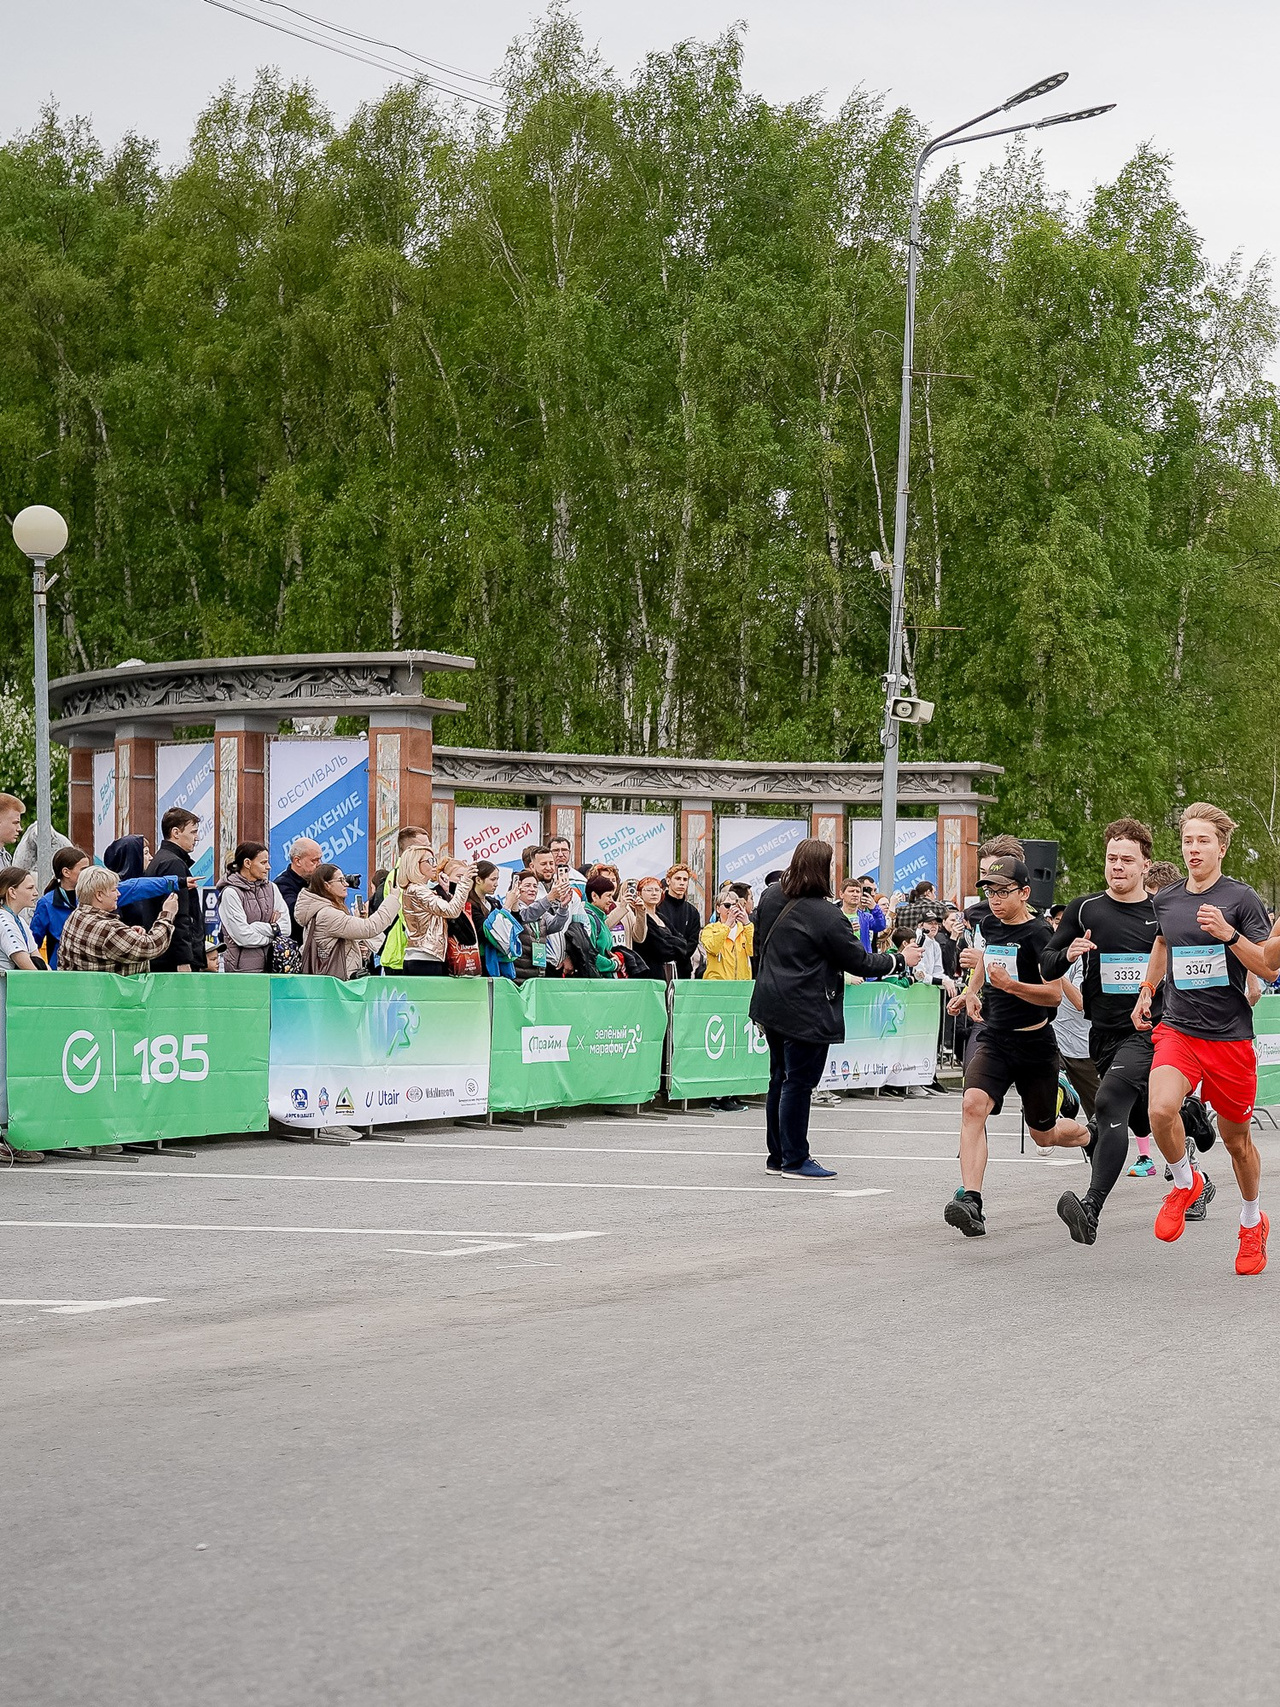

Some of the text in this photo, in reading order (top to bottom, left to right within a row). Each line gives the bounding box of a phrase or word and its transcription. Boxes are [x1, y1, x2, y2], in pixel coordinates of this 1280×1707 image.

[186, 757, 214, 797] ВМЕСТ
[277, 754, 348, 809] ФЕСТИВАЛЬ
[463, 824, 500, 851] БЫТЬ
[598, 824, 636, 851] БЫТЬ
[603, 822, 666, 866] ДВИЖЕНИИ
[724, 827, 799, 873] БЫТЬ ВМЕСТЕ
[1114, 970, 1141, 981] 3332
[1185, 963, 1213, 975] 3347
[532, 1035, 562, 1053] Прайм
[594, 1025, 627, 1040] зелёный
[743, 1020, 769, 1054] 18
[133, 1034, 210, 1084] 185
[589, 1040, 624, 1056] марафон
[377, 1089, 400, 1107] Utair
